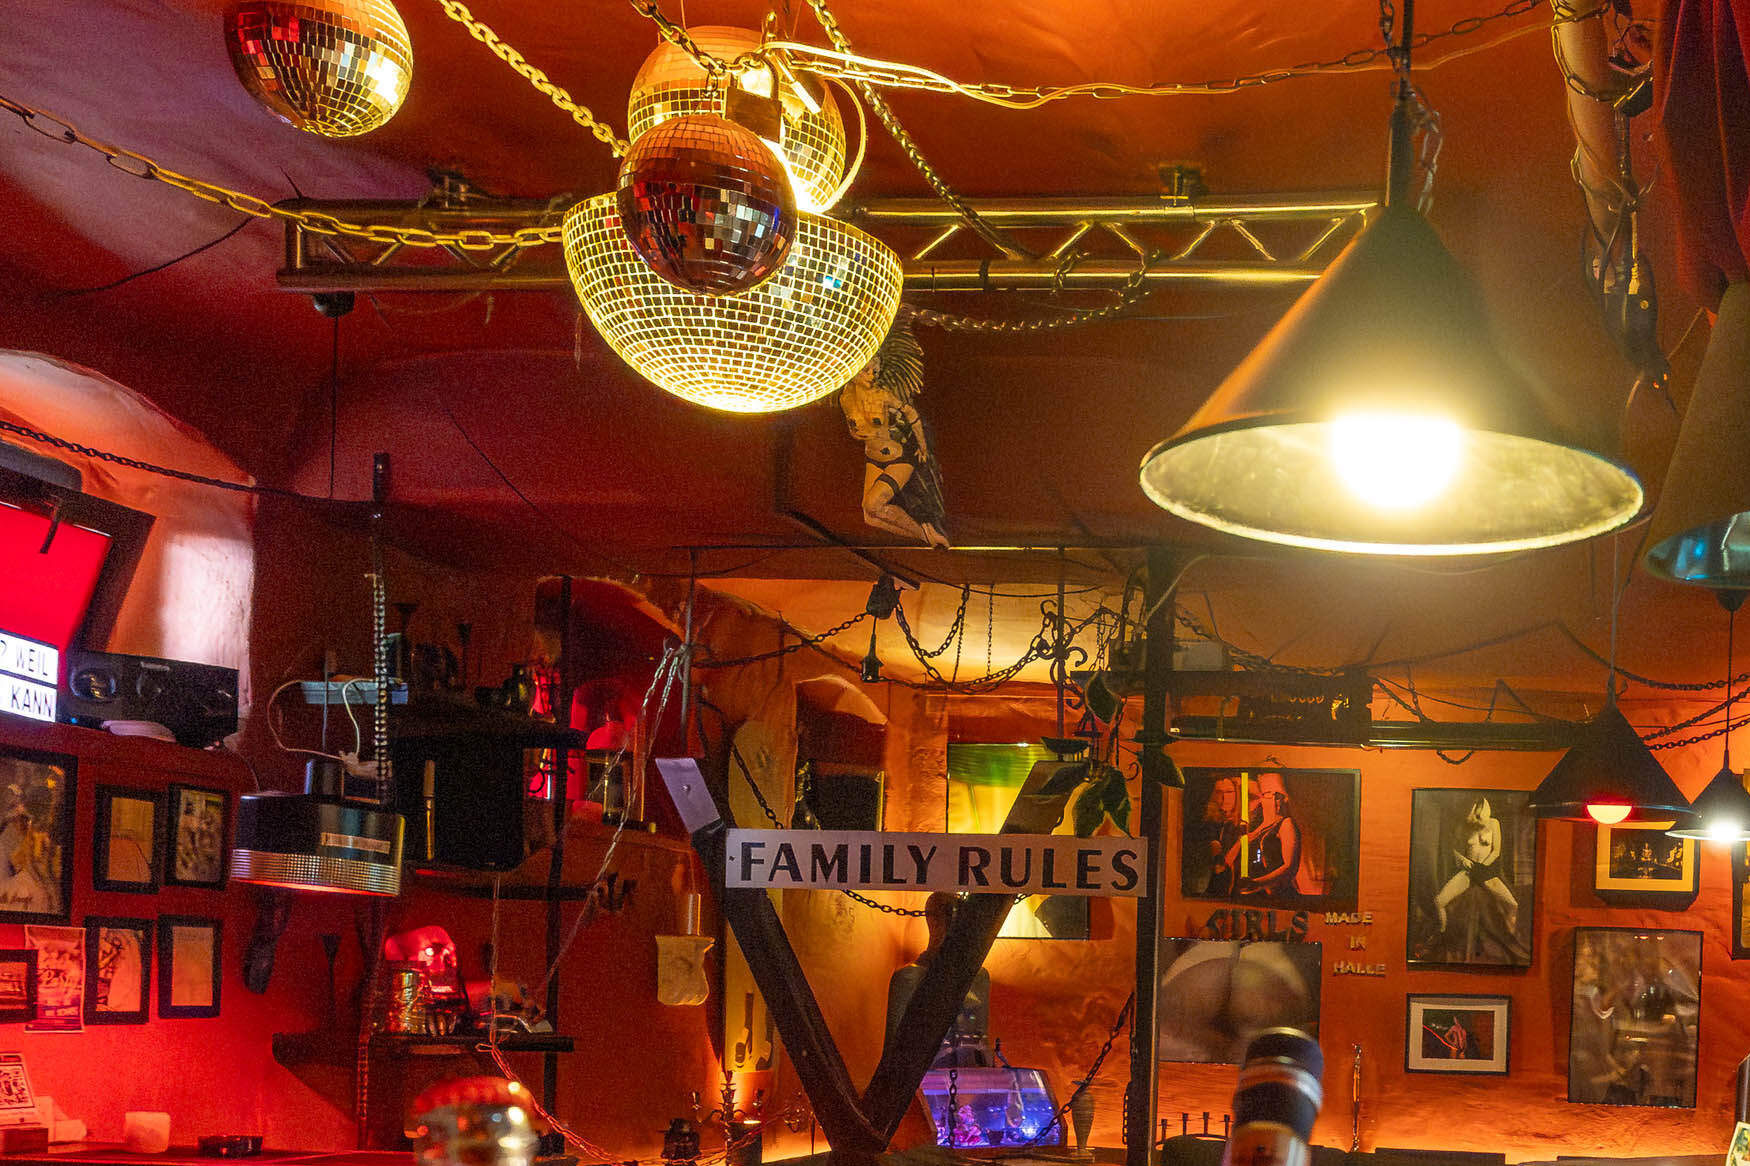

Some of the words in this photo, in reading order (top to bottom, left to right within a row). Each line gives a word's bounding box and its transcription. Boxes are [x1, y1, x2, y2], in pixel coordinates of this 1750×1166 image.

[15, 643, 48, 677] WEIL
[11, 683, 53, 717] KANN
[740, 841, 937, 885] FAMILY
[957, 846, 1139, 891] RULES
